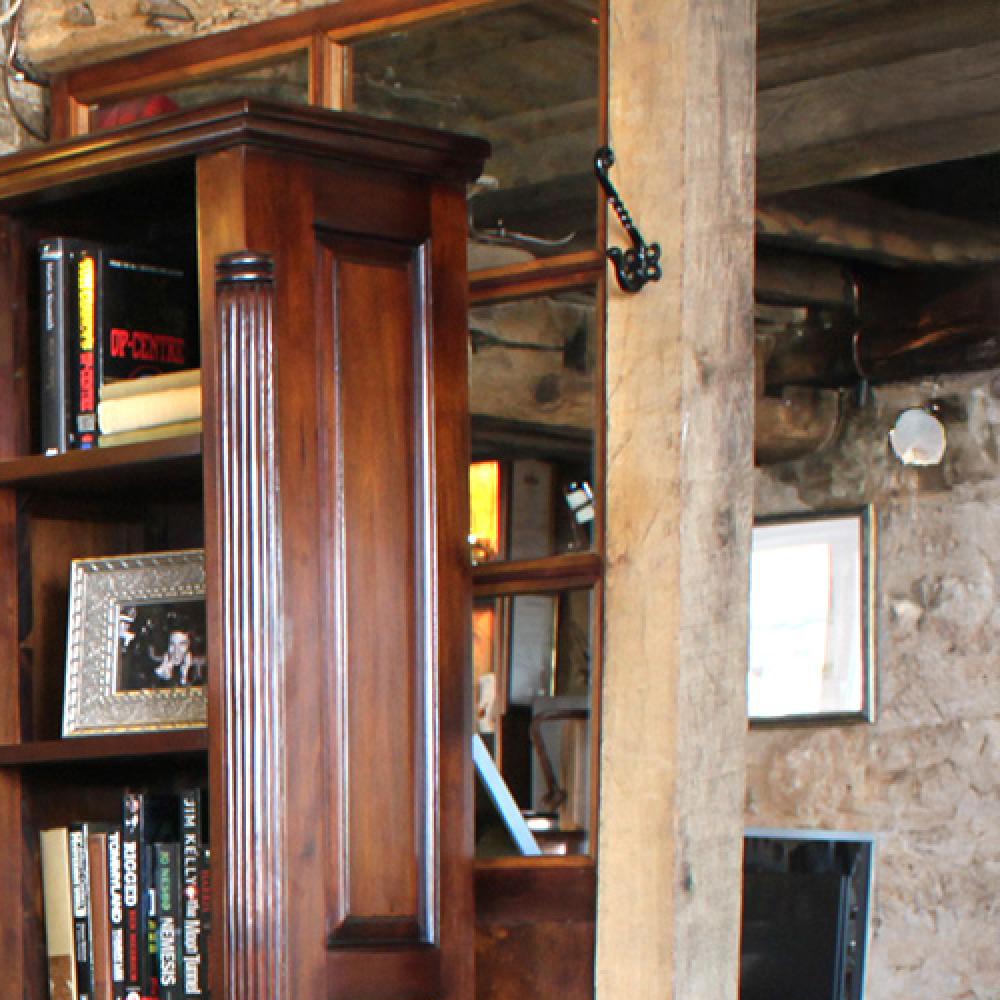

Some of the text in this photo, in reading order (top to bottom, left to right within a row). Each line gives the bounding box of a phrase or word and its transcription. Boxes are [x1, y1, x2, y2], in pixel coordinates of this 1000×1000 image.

[183, 798, 198, 828] JIM
[183, 833, 198, 884] KELLY
[159, 916, 177, 986] NEMESIS
